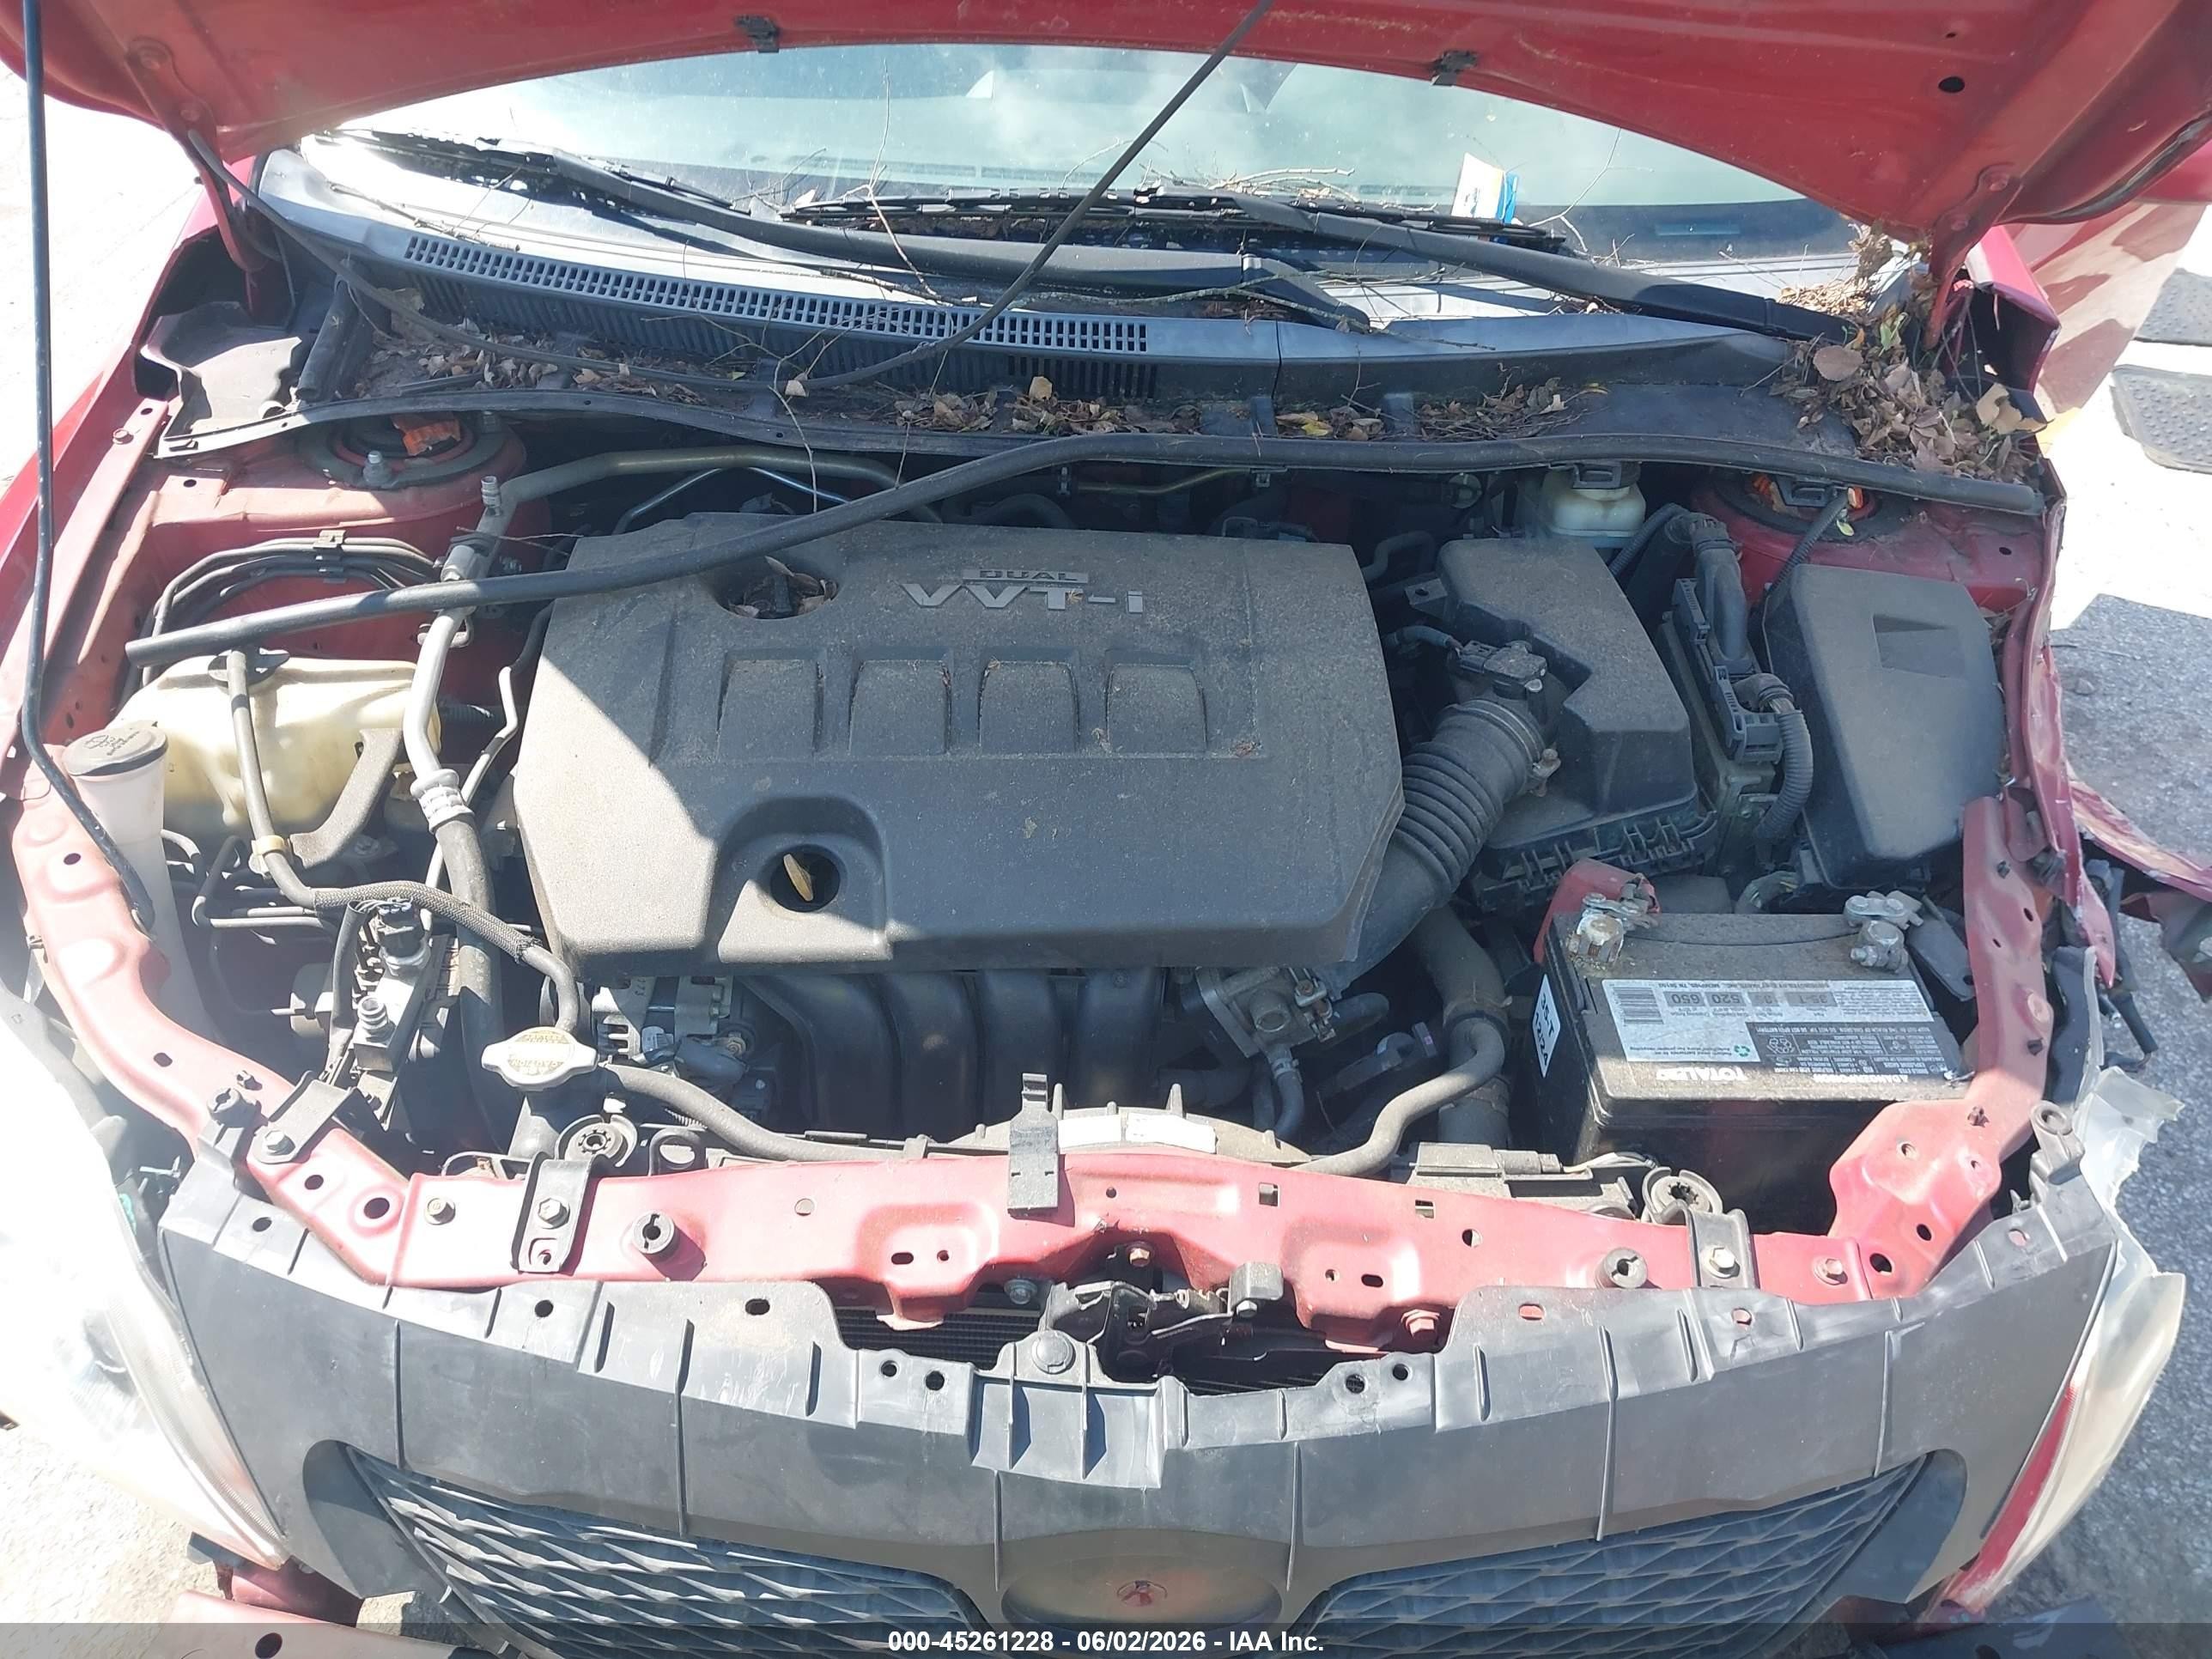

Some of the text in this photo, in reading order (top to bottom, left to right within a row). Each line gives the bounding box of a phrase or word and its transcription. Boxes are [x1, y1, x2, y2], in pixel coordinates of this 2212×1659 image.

[977, 568, 1081, 582] DUAL
[901, 583, 1145, 614] VVT-i
[1671, 994, 1700, 1004] 650
[1711, 994, 1740, 1004] 520
[1540, 993, 1554, 1036] 35-T
[1534, 1013, 1549, 1066] 12/24
